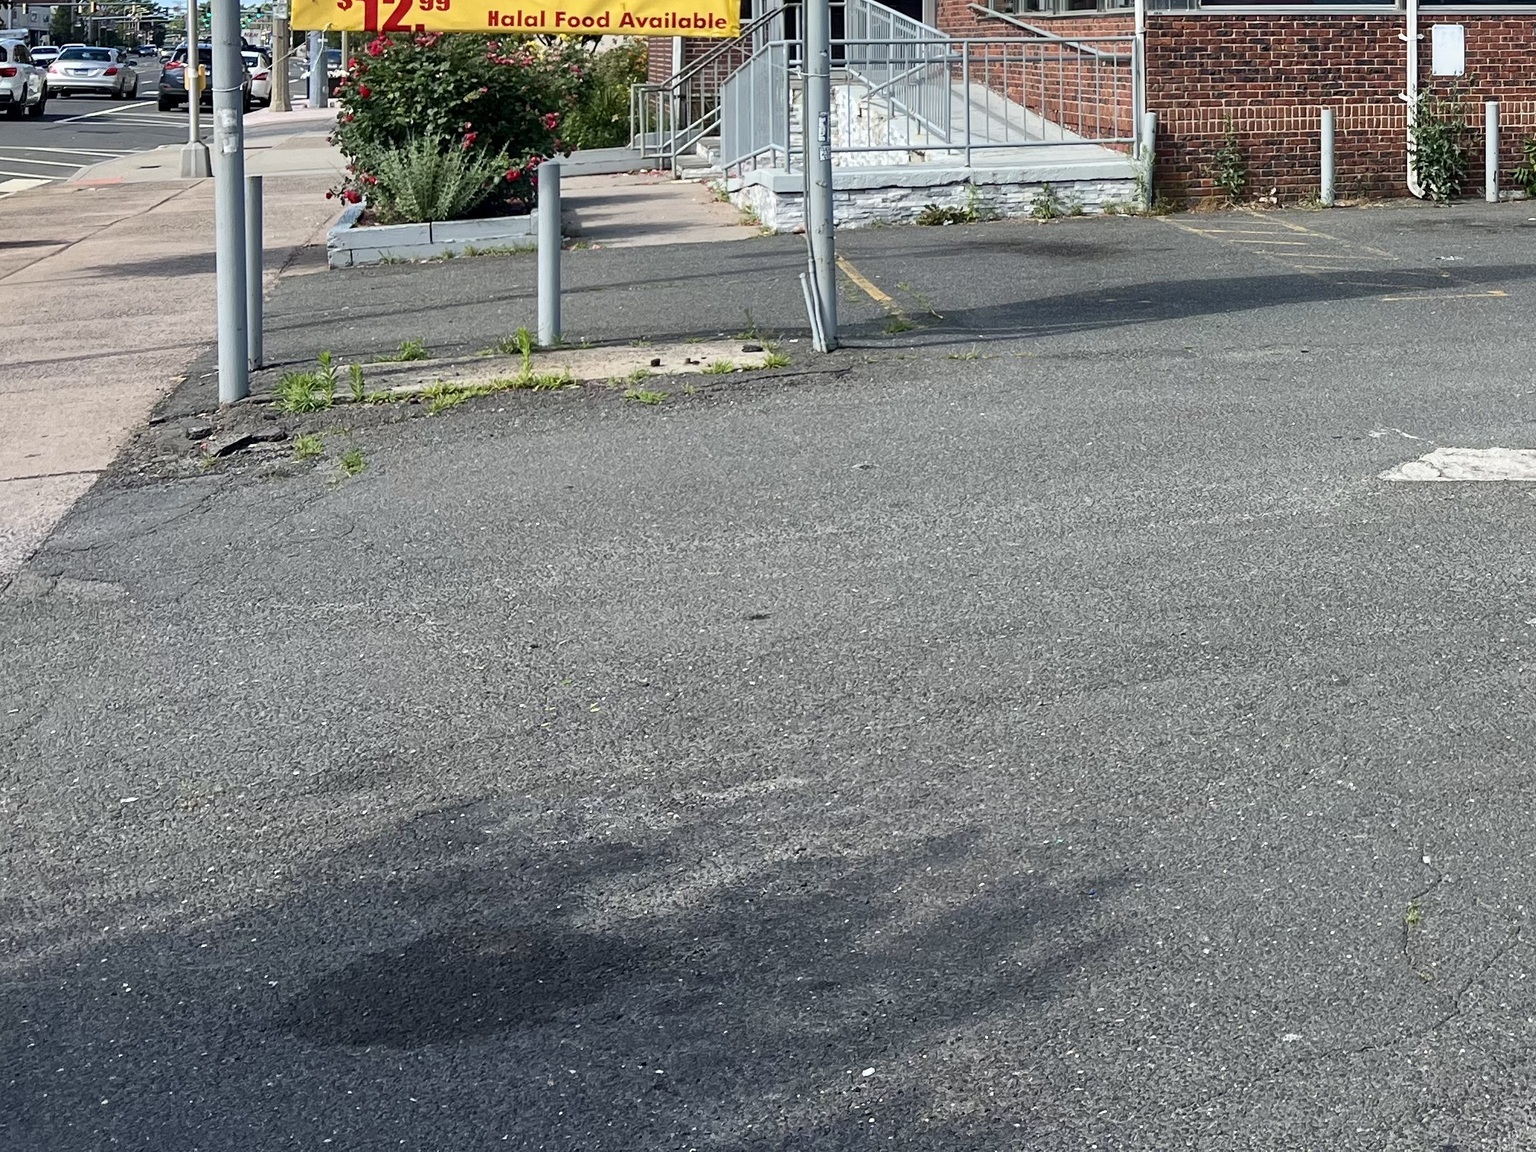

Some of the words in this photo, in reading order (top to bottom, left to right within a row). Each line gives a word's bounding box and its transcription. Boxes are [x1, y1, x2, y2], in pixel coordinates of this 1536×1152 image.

[487, 9, 546, 28] Halal
[555, 10, 610, 28] Food
[619, 11, 728, 30] Available
